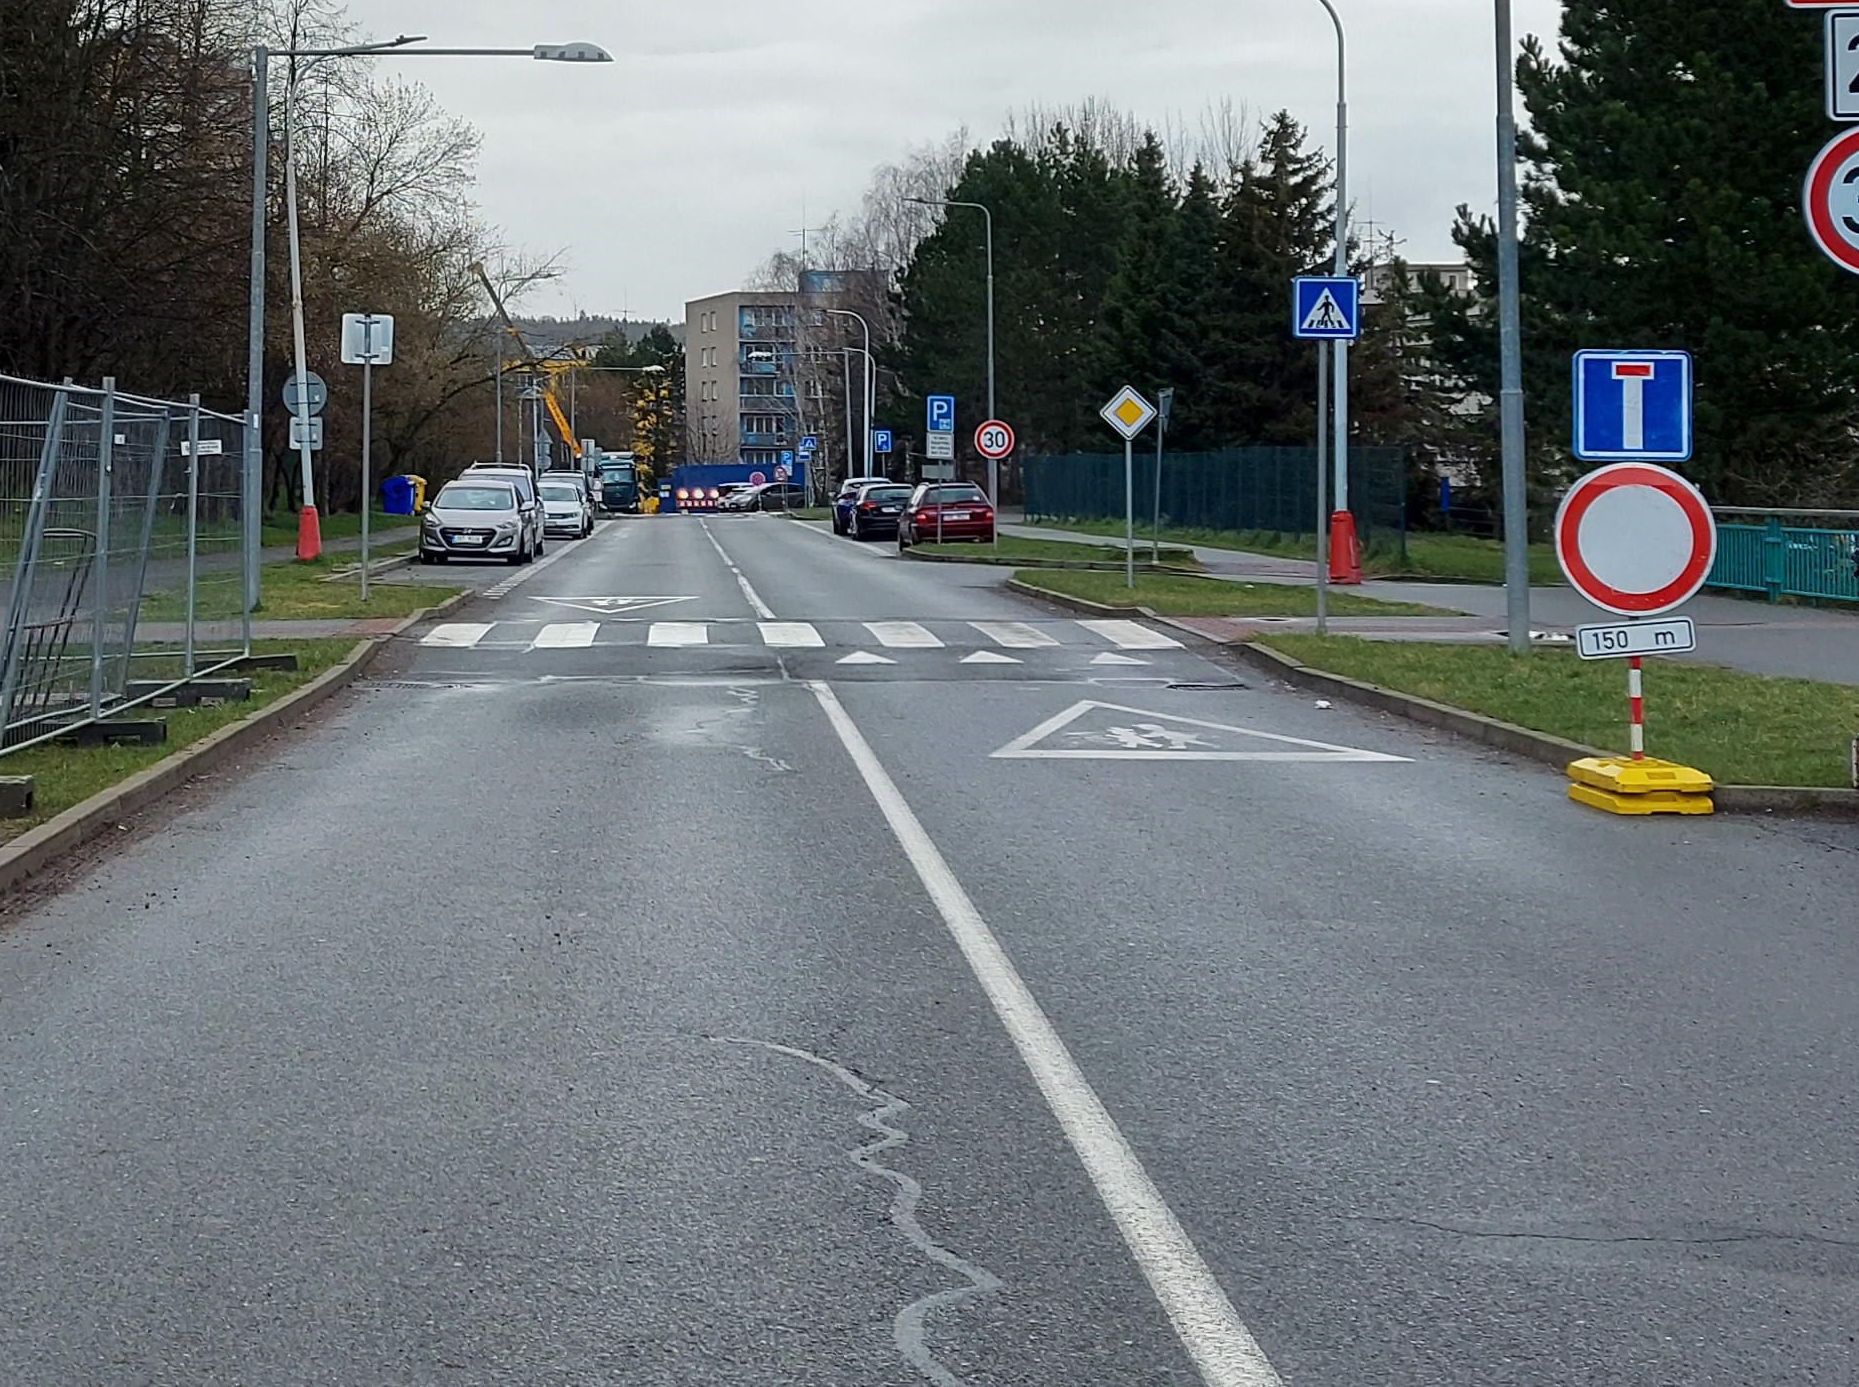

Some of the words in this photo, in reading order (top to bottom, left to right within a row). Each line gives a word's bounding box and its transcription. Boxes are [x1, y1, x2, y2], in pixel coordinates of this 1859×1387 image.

[933, 401, 948, 422] P
[878, 433, 888, 446] P
[983, 431, 1006, 449] 30
[1592, 630, 1629, 651] 150
[1654, 630, 1676, 646] m
